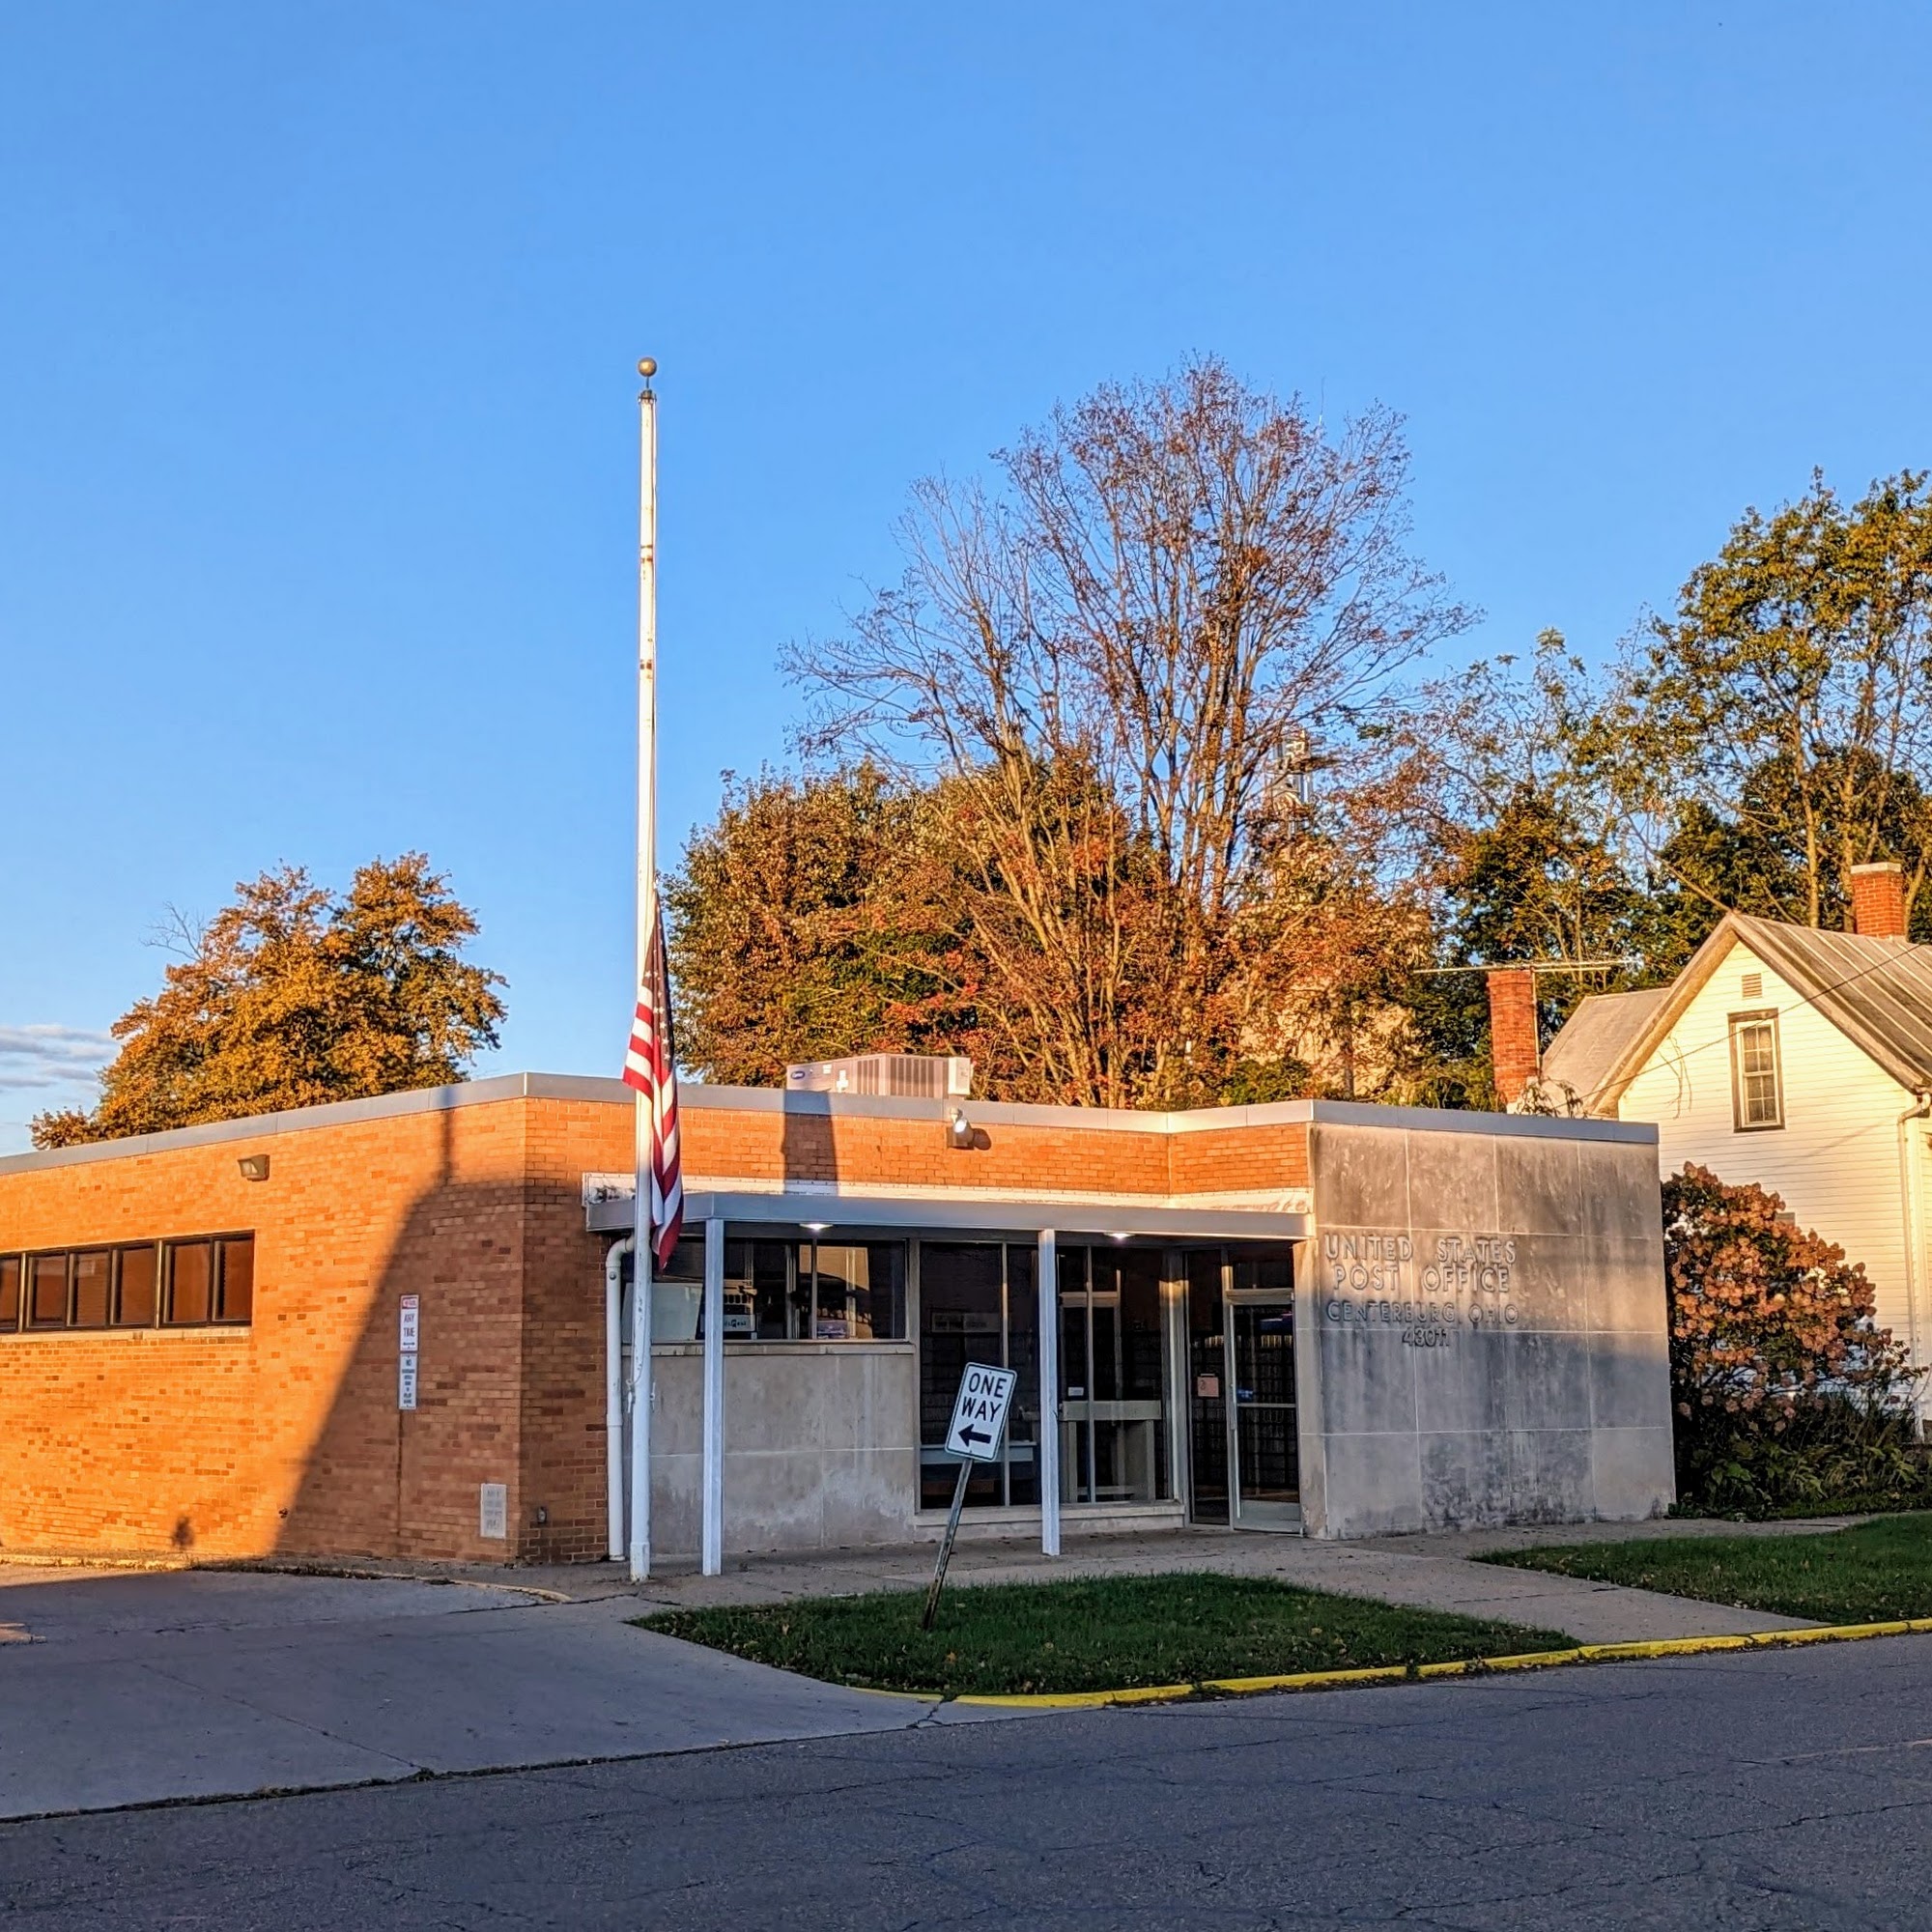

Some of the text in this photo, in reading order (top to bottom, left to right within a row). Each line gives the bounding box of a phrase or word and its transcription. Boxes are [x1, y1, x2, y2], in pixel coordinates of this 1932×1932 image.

[1324, 1234, 1517, 1264] UNITED STATES
[1333, 1264, 1510, 1293] POST OFFICE
[1468, 1304, 1520, 1324] OHIO
[1402, 1326, 1450, 1348] 43011
[969, 1373, 1007, 1398] ONE
[961, 1396, 1002, 1422] WAY
